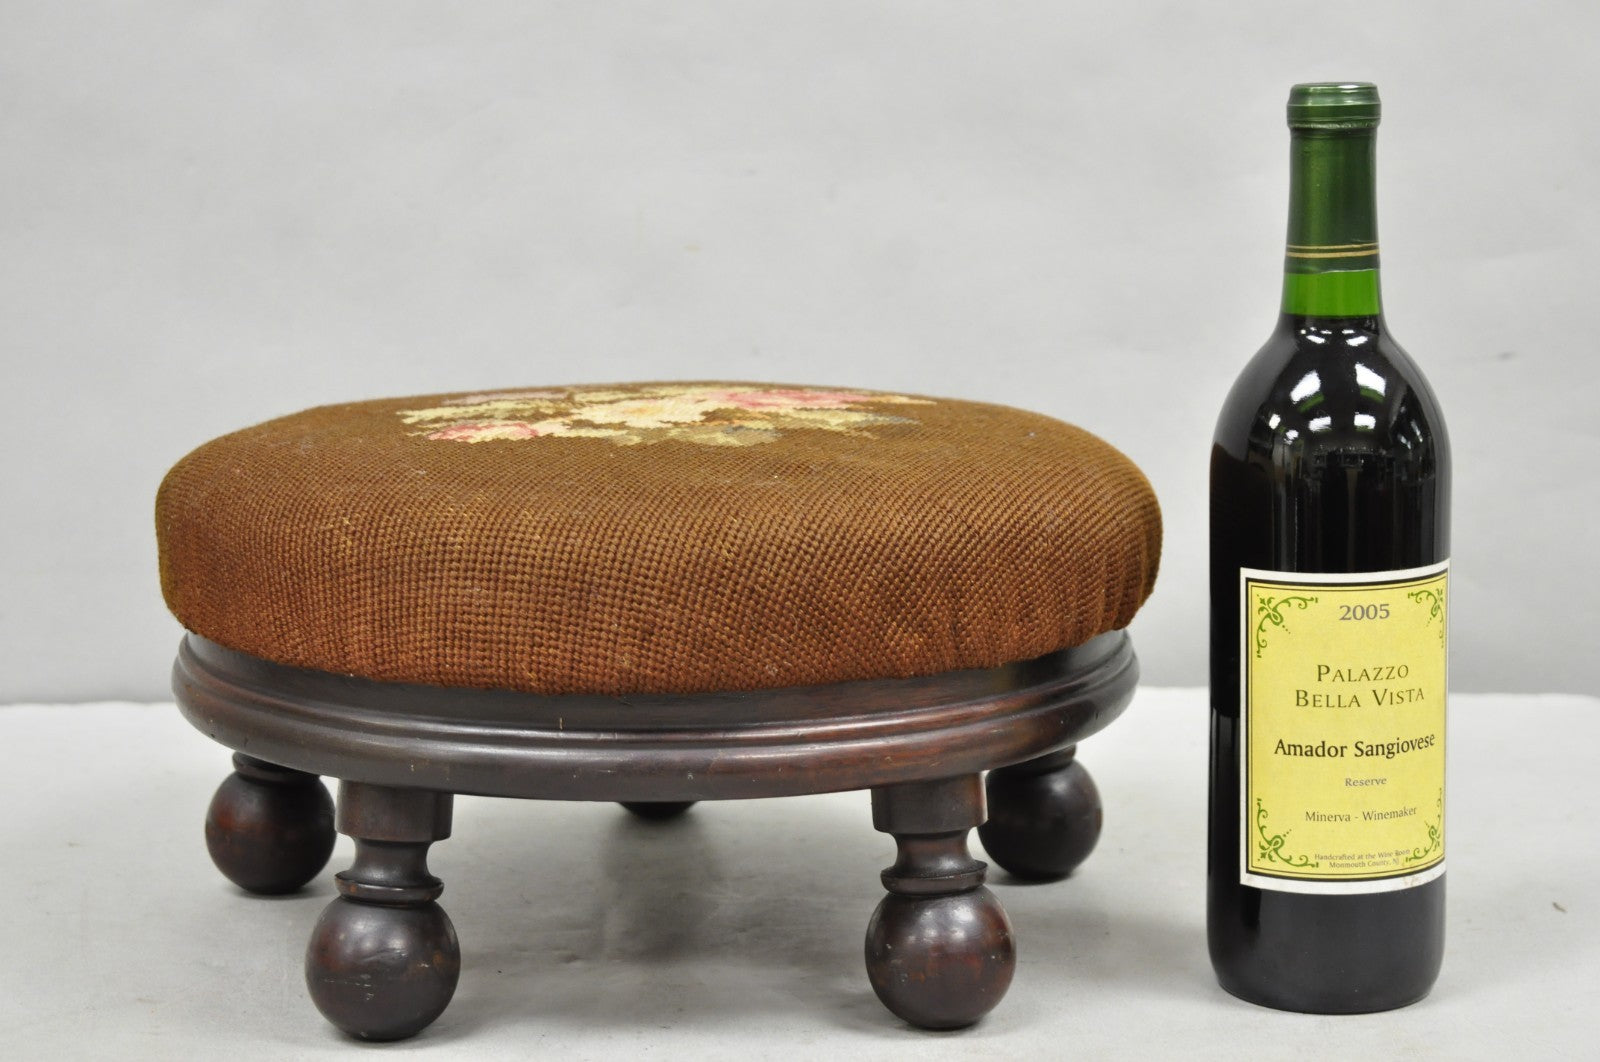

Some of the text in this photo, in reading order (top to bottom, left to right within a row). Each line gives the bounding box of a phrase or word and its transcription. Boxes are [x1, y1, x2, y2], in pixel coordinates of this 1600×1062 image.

[1339, 603, 1390, 621] 2005
[1317, 664, 1409, 682] PALAZZO
[1295, 687, 1425, 708] BELLA VISTA
[1274, 733, 1435, 760] Amador Sangiovese
[1344, 777, 1387, 787] Reserve
[1305, 811, 1351, 822] Minerva
[1362, 806, 1417, 821] Winemaker
[1314, 853, 1355, 861] Handcrafted
[1328, 861, 1366, 869] Monmouth
